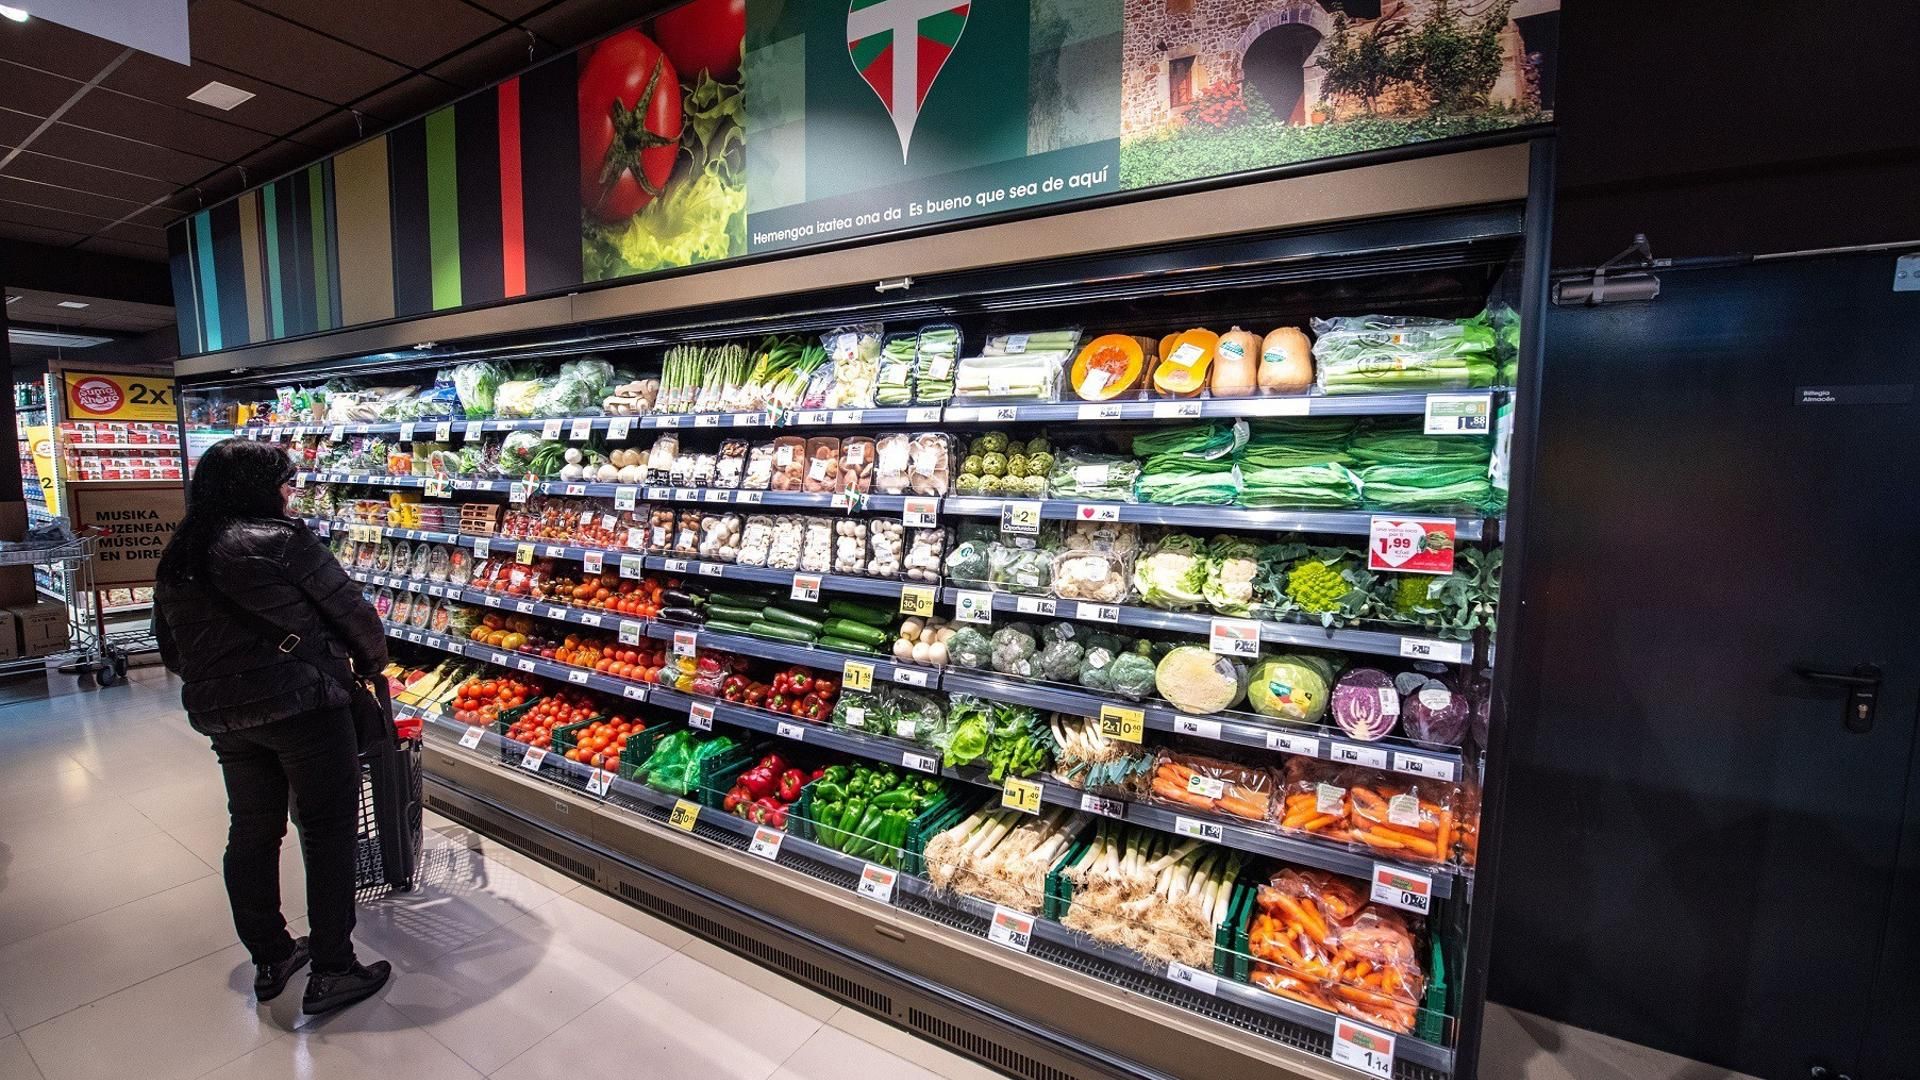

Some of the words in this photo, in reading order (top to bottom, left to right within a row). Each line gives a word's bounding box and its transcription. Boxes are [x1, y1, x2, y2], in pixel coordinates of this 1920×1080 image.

[753, 224, 813, 245] Hemengoa
[816, 218, 852, 234] izatea
[855, 212, 880, 226] ona
[883, 207, 901, 220] da
[909, 202, 922, 217] Es
[926, 195, 972, 214] bueno
[975, 188, 1005, 207] que
[1009, 182, 1037, 199] sea
[1041, 176, 1064, 193] de
[1068, 165, 1109, 188] aquí
[96, 510, 159, 521] MUSIKA
[97, 521, 176, 534] UZENEAN
[100, 534, 162, 548] MÚSICA
[100, 551, 120, 561] EN
